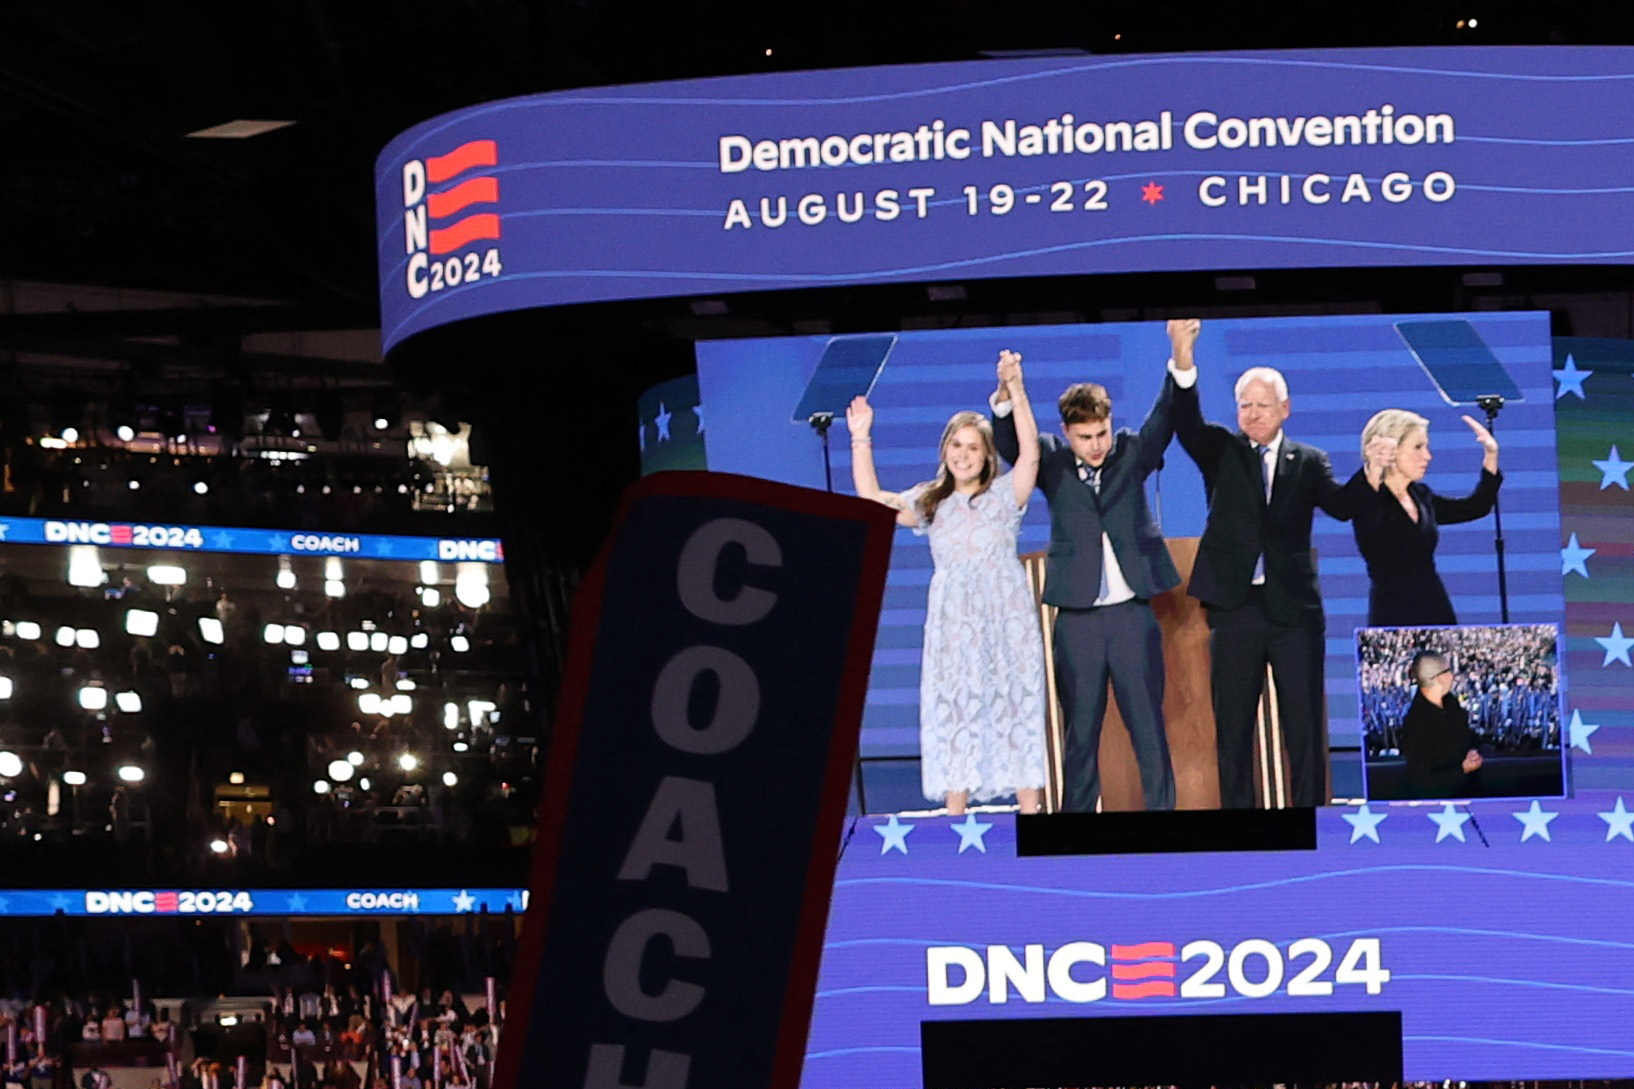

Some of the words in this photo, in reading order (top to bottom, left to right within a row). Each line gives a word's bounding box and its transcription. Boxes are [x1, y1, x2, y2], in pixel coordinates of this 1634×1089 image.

[719, 118, 971, 173] Democratic
[981, 110, 1172, 160] National
[1182, 104, 1455, 149] Convention
[723, 188, 936, 230] AUGUST
[964, 180, 1111, 215] 19-22
[1199, 171, 1456, 208] CHICAGO
[404, 159, 428, 299] DNC
[430, 249, 503, 290] 2024
[45, 521, 110, 545] DNC
[132, 525, 203, 549] 2024
[291, 534, 360, 553] COACH
[438, 540, 496, 561] DNC
[85, 891, 155, 913] DNC
[178, 891, 252, 913] 2024
[346, 892, 418, 911] COACH
[926, 945, 1106, 1005] DNC
[1180, 938, 1390, 999] 2024
